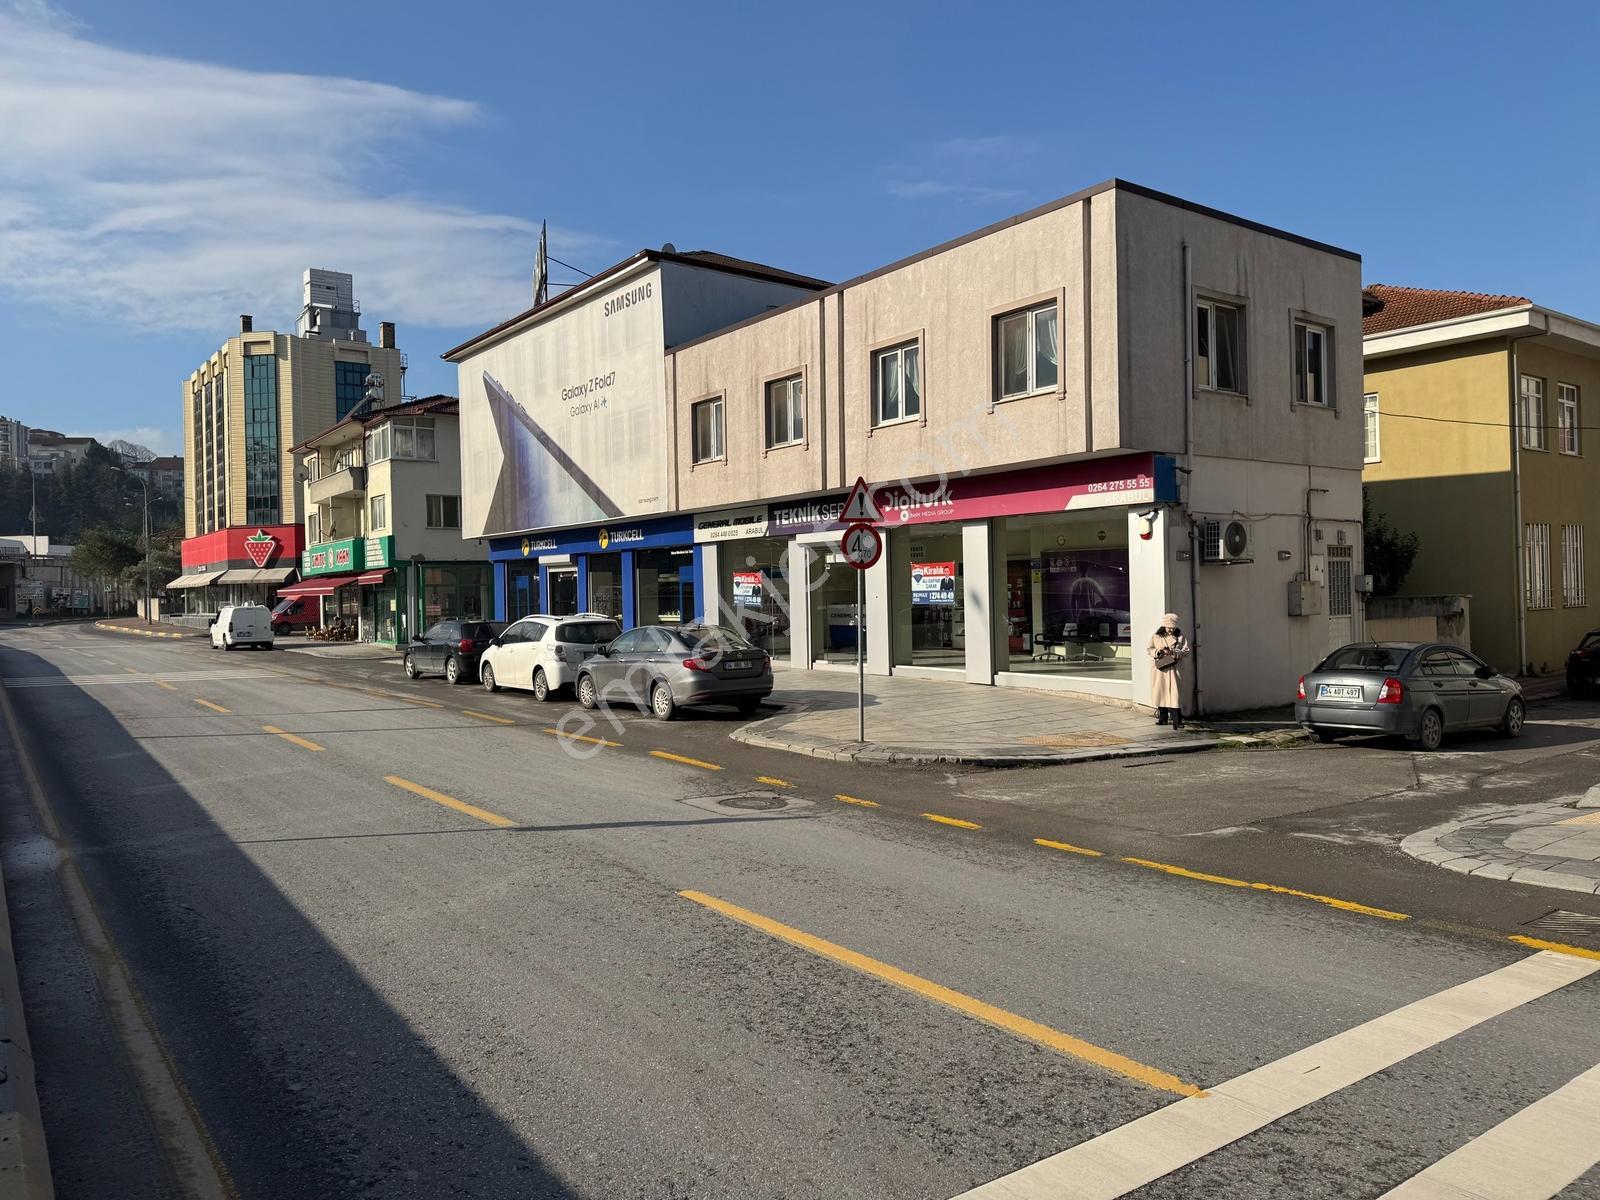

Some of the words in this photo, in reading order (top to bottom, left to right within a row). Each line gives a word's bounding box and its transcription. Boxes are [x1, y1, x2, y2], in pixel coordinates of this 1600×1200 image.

[604, 282, 652, 317] SAMSUNG
[561, 382, 589, 401] Galaxy
[589, 379, 594, 393] Z
[594, 371, 616, 391] Fold7
[570, 403, 592, 417] Galaxy
[1087, 483, 1107, 493] 0264
[1109, 481, 1125, 491] 275
[1126, 479, 1137, 489] 55
[1139, 478, 1150, 488] 55
[698, 518, 732, 530] GENERAL
[732, 515, 763, 526] MOBILE
[610, 528, 644, 543] TURKCELL
[530, 539, 558, 551] TURKCELL
